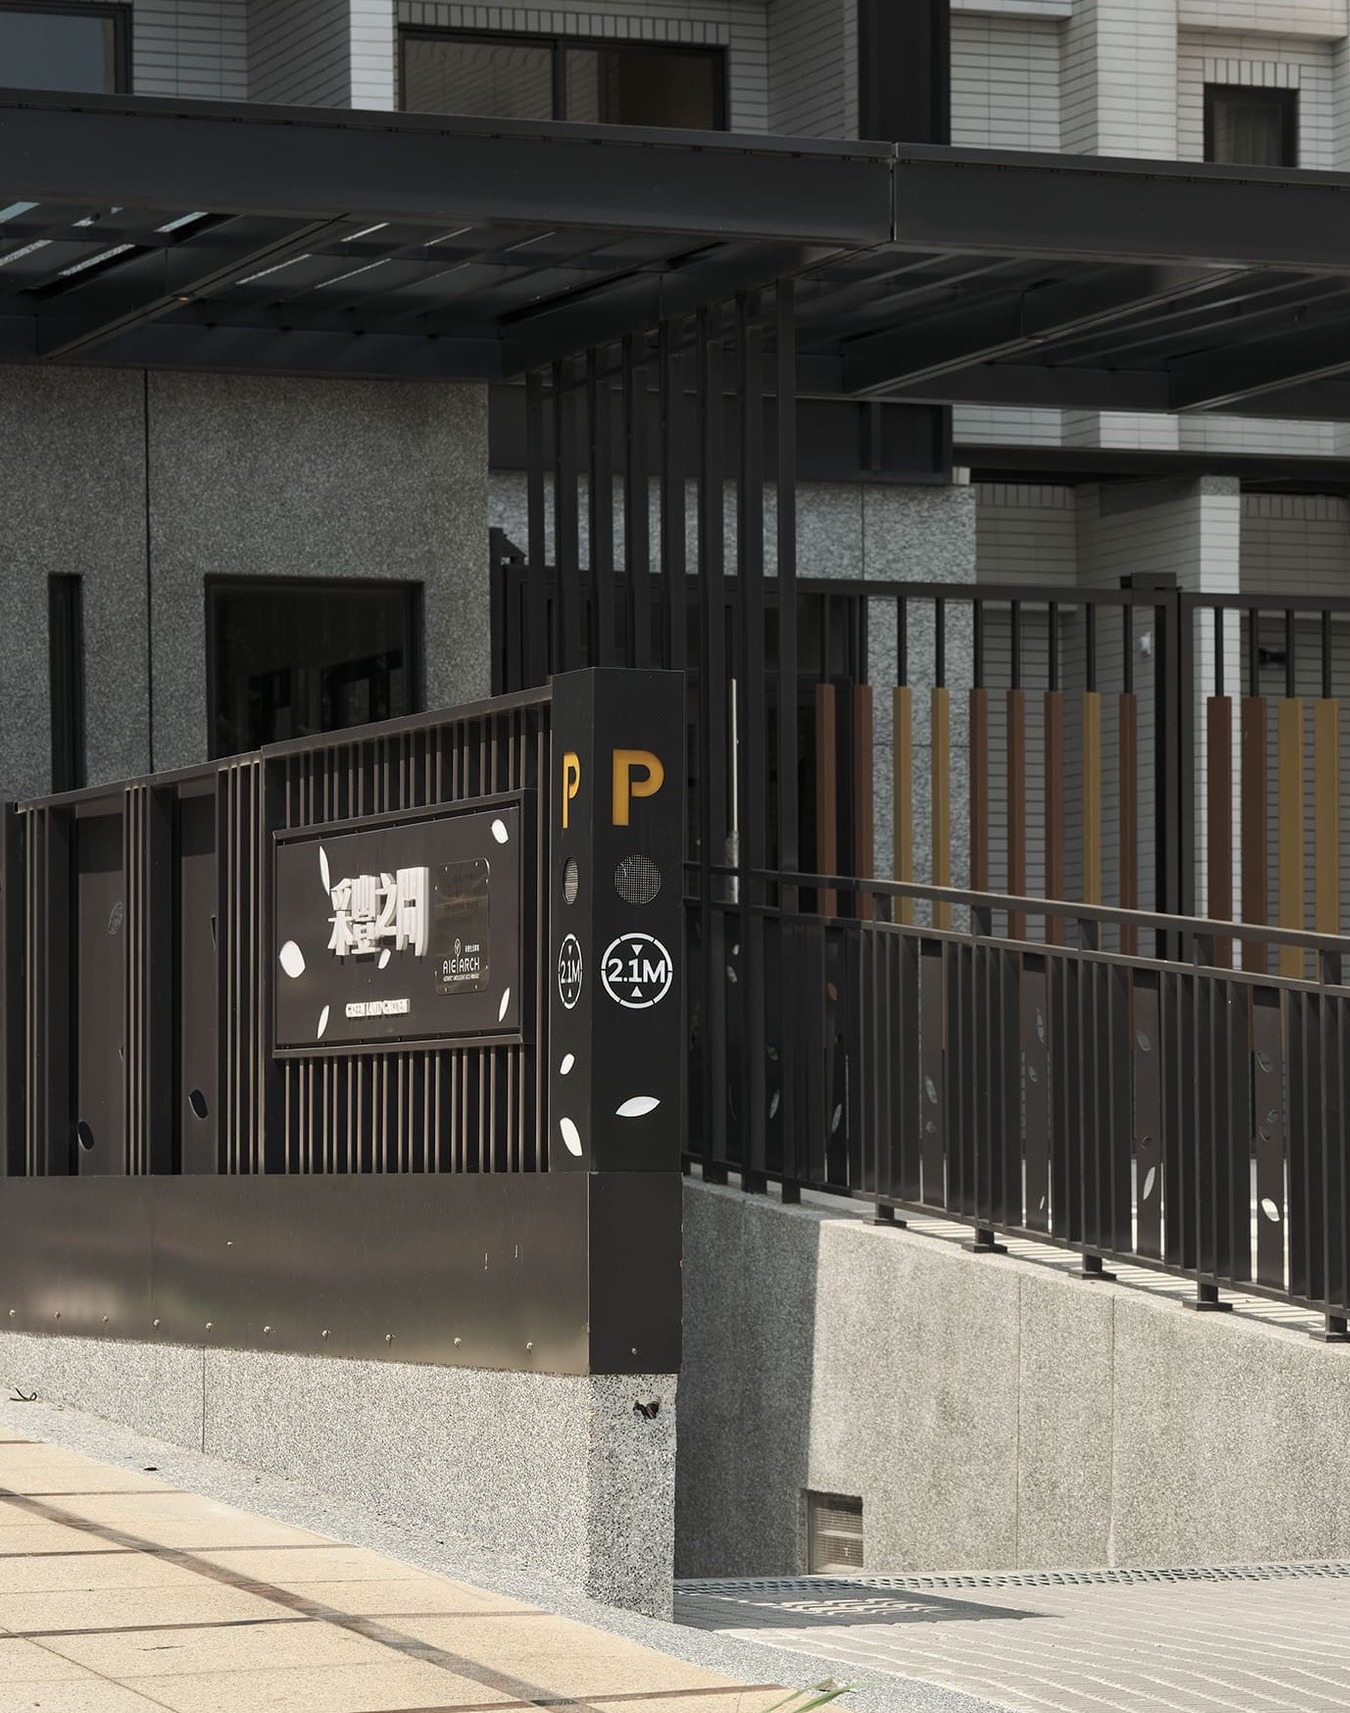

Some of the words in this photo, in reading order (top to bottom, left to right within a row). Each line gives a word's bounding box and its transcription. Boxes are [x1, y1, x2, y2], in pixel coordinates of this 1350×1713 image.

[562, 752, 580, 828] P
[613, 750, 663, 825] P
[459, 957, 480, 973] ARCH
[560, 959, 580, 984] 2.1M
[608, 957, 665, 984] 2.1M
